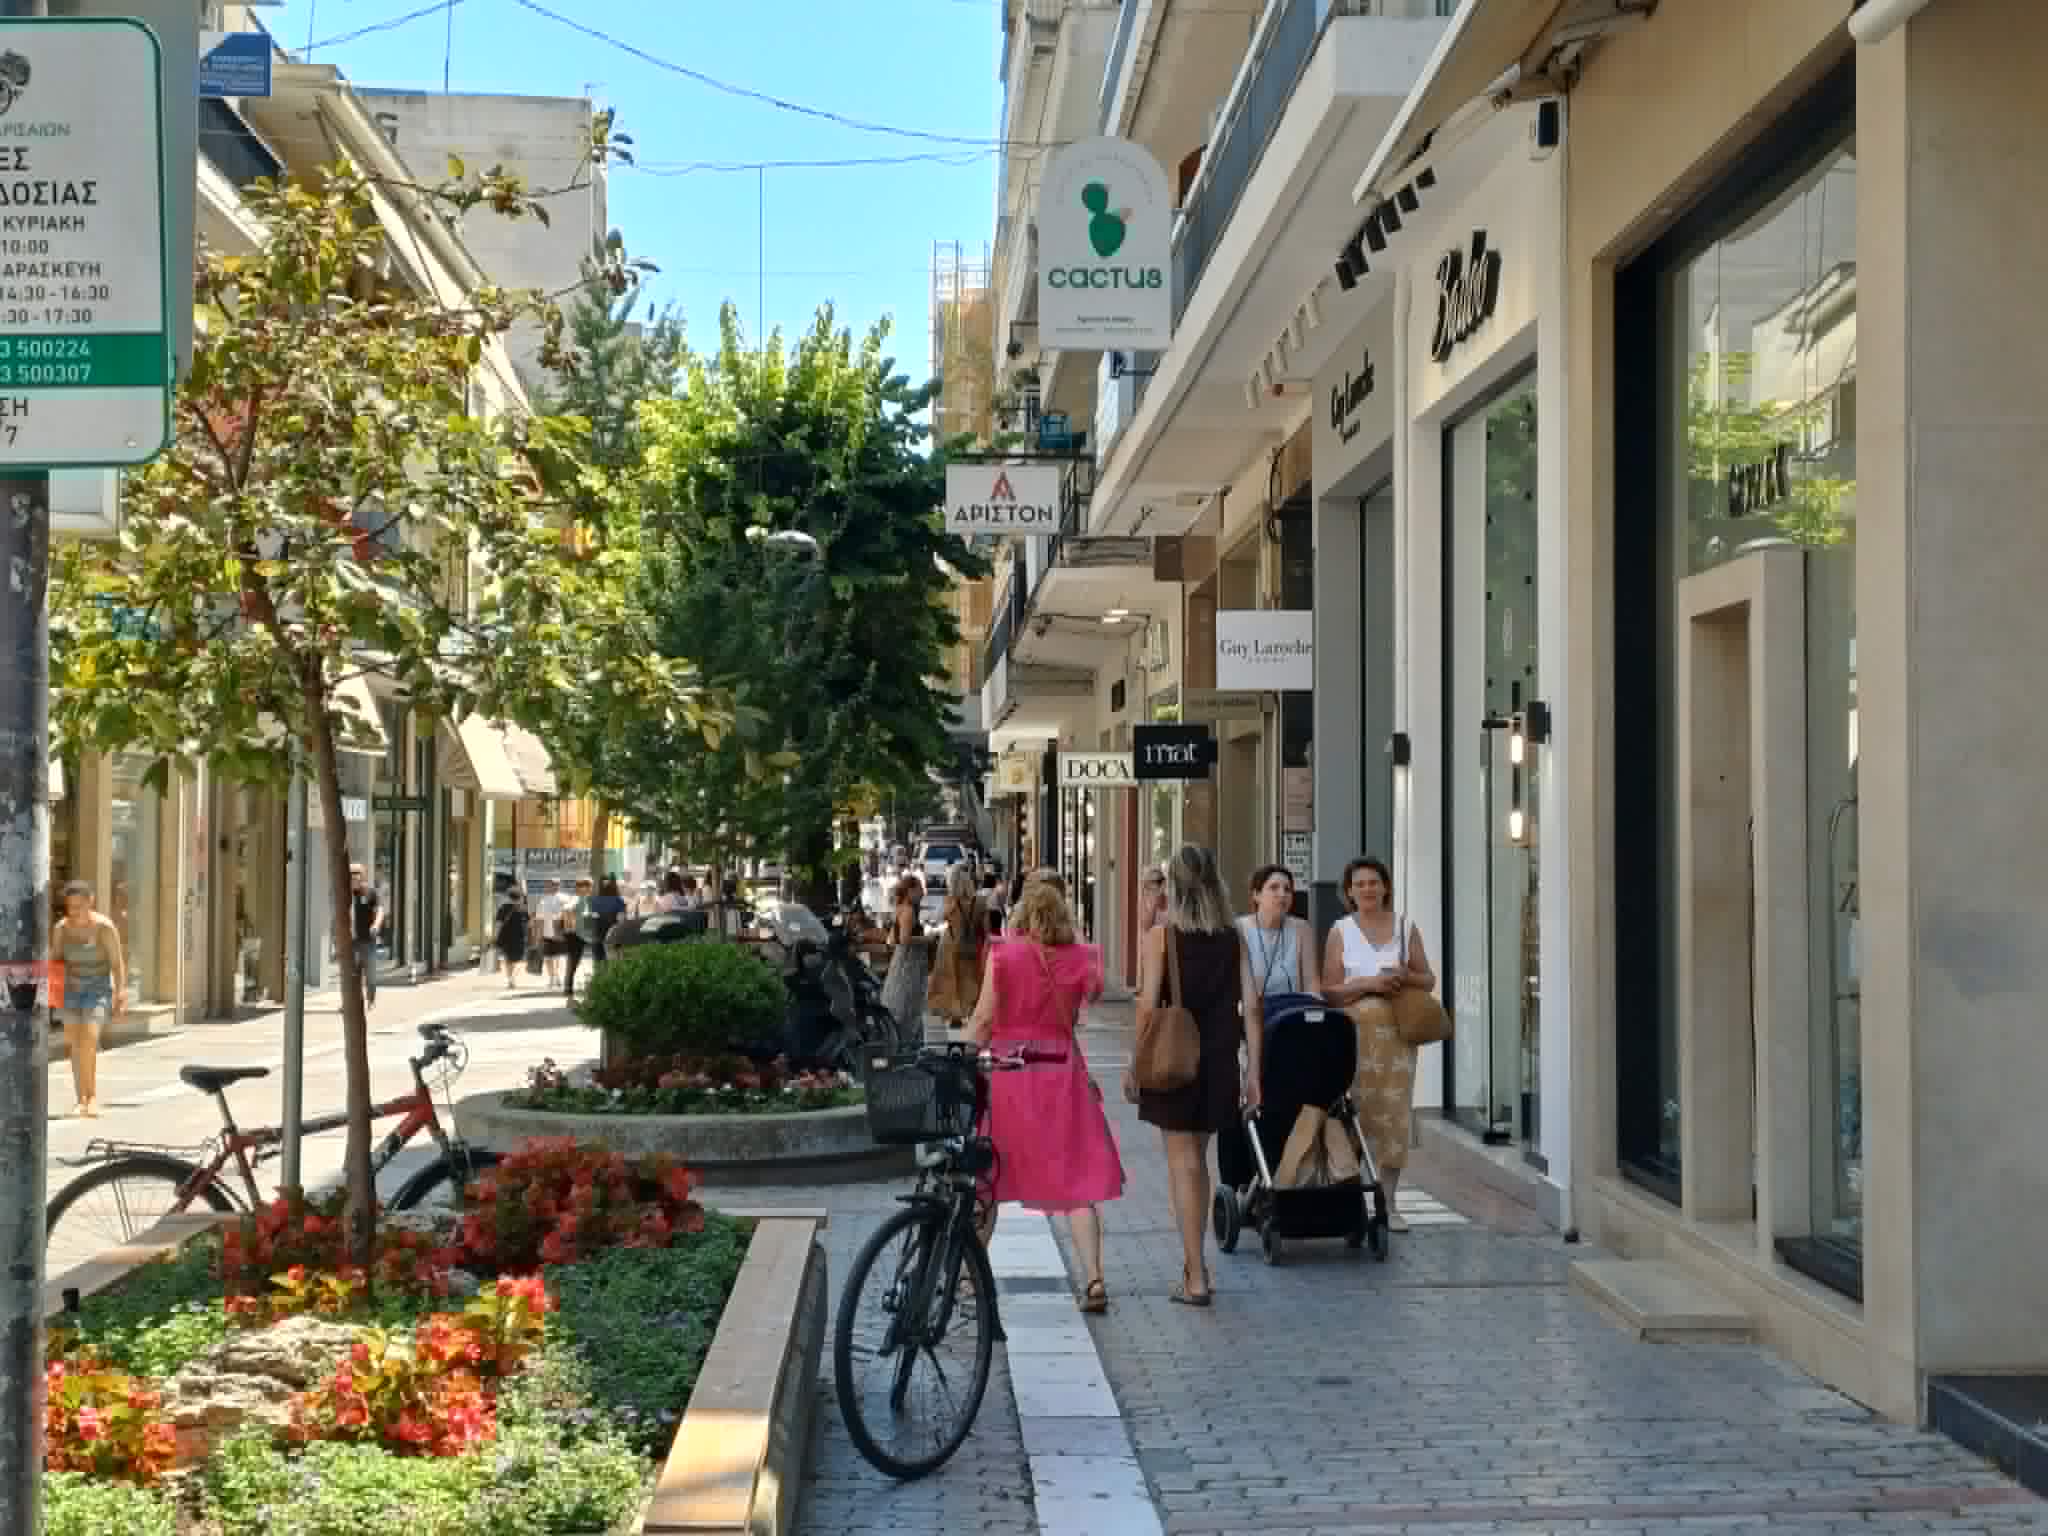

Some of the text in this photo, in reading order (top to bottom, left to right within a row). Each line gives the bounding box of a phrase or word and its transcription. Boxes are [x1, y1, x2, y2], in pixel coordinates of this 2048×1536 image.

[3, 214, 86, 232] ΚΥΡΙΑΚΗ
[2, 239, 49, 256] 10:00
[16, 338, 91, 359] 500224
[17, 363, 92, 384] 500307
[954, 503, 1053, 523] ΑΡΙΣΤΟΝ
[1219, 639, 1248, 660] Guy
[1067, 759, 1130, 779] DOCA
